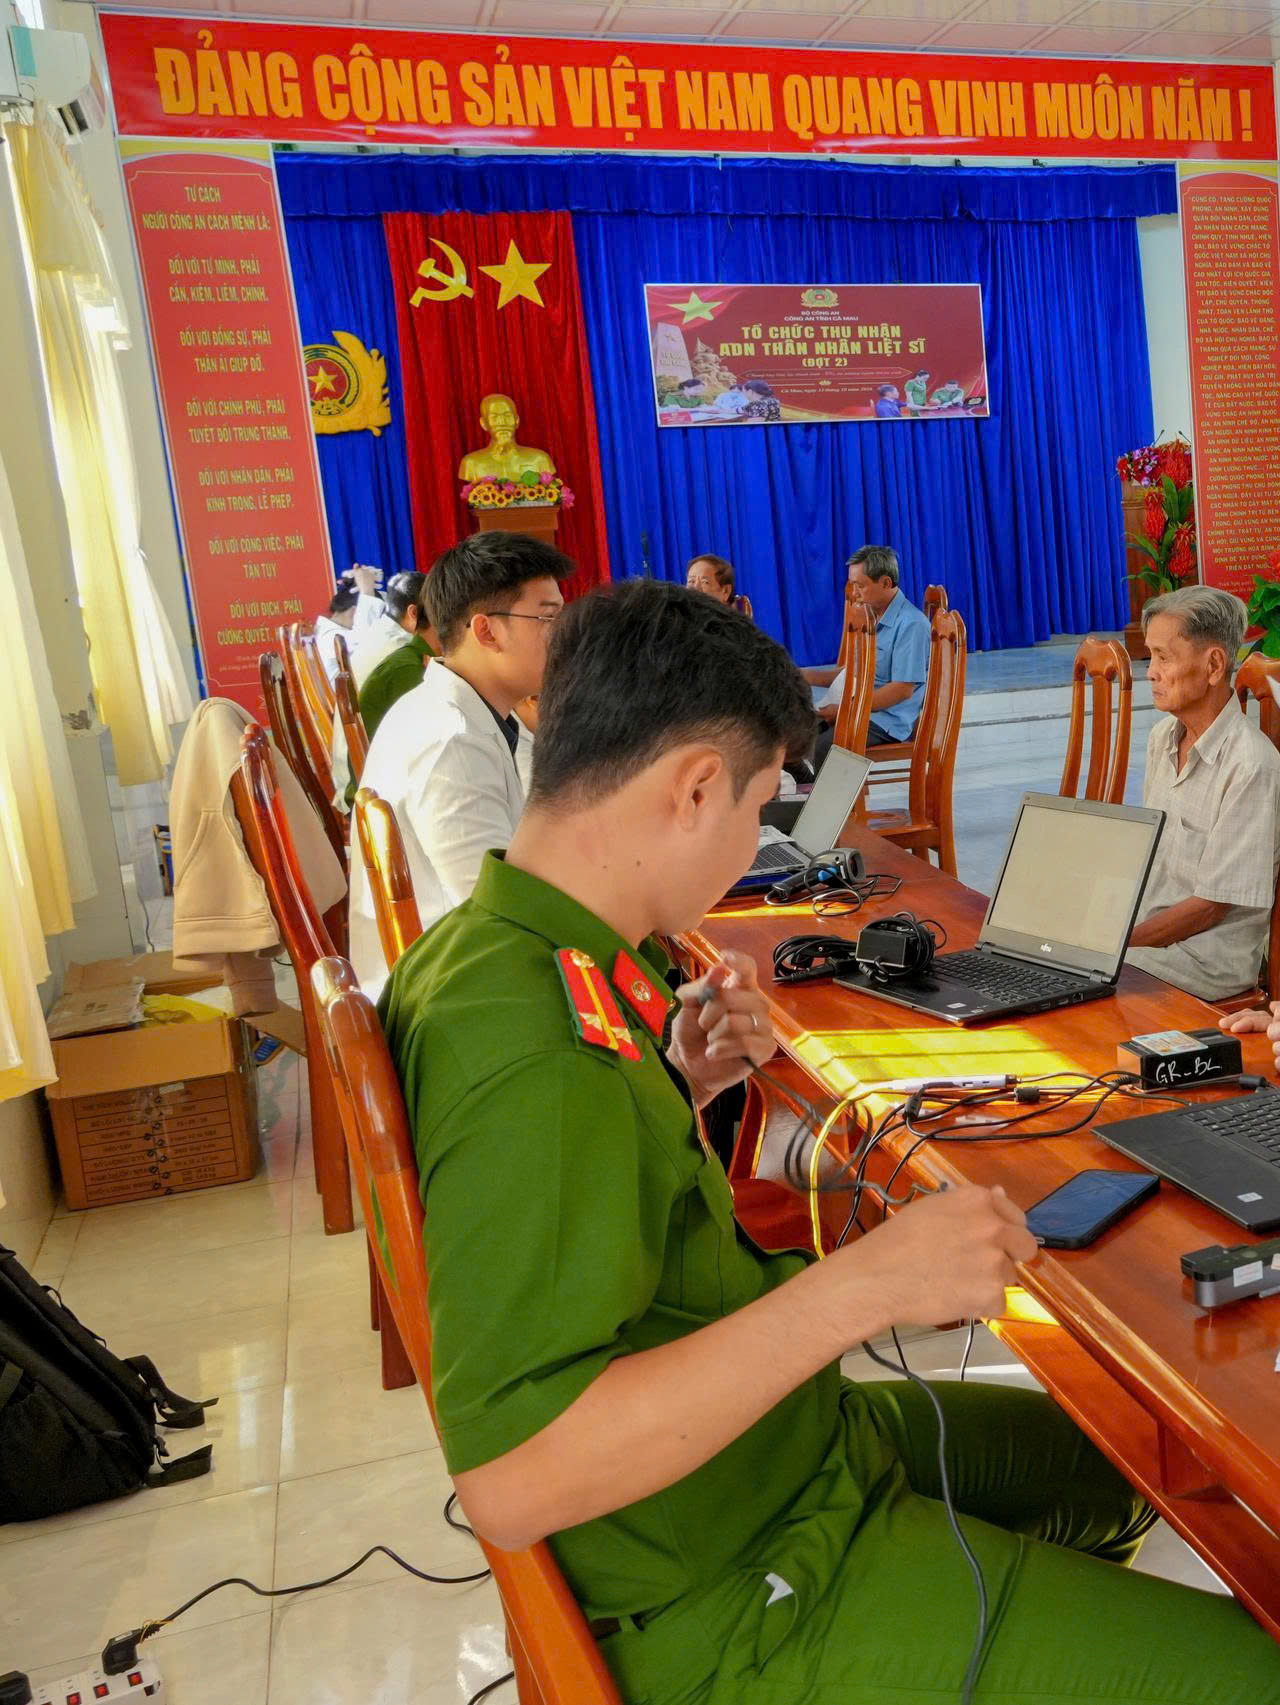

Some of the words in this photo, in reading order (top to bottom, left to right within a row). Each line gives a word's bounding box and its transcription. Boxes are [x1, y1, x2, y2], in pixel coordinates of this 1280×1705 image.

[154, 29, 304, 119] ĐẢNG
[313, 43, 452, 136] CỘNG
[459, 44, 557, 127] SẢN
[560, 55, 665, 142] VIỆT
[675, 70, 774, 132] NAM
[782, 74, 924, 140] QUANG
[929, 79, 1026, 138] VINH
[1033, 73, 1143, 142] MUÔN
[1151, 77, 1233, 143] NĂM
[195, 213, 206, 230] AN
[741, 323, 763, 339] TỔ
[768, 322, 815, 339] CHỨC
[820, 325, 852, 339] THU
[857, 322, 901, 340] NHẬN
[719, 342, 756, 357] ADN
[762, 339, 808, 356] THÂN
[814, 338, 862, 355] NHÂN
[867, 338, 903, 357] LIỆT
[908, 337, 926, 354] SĨ
[801, 357, 831, 369] (ĐỢT
[835, 357, 848, 368] 2)
